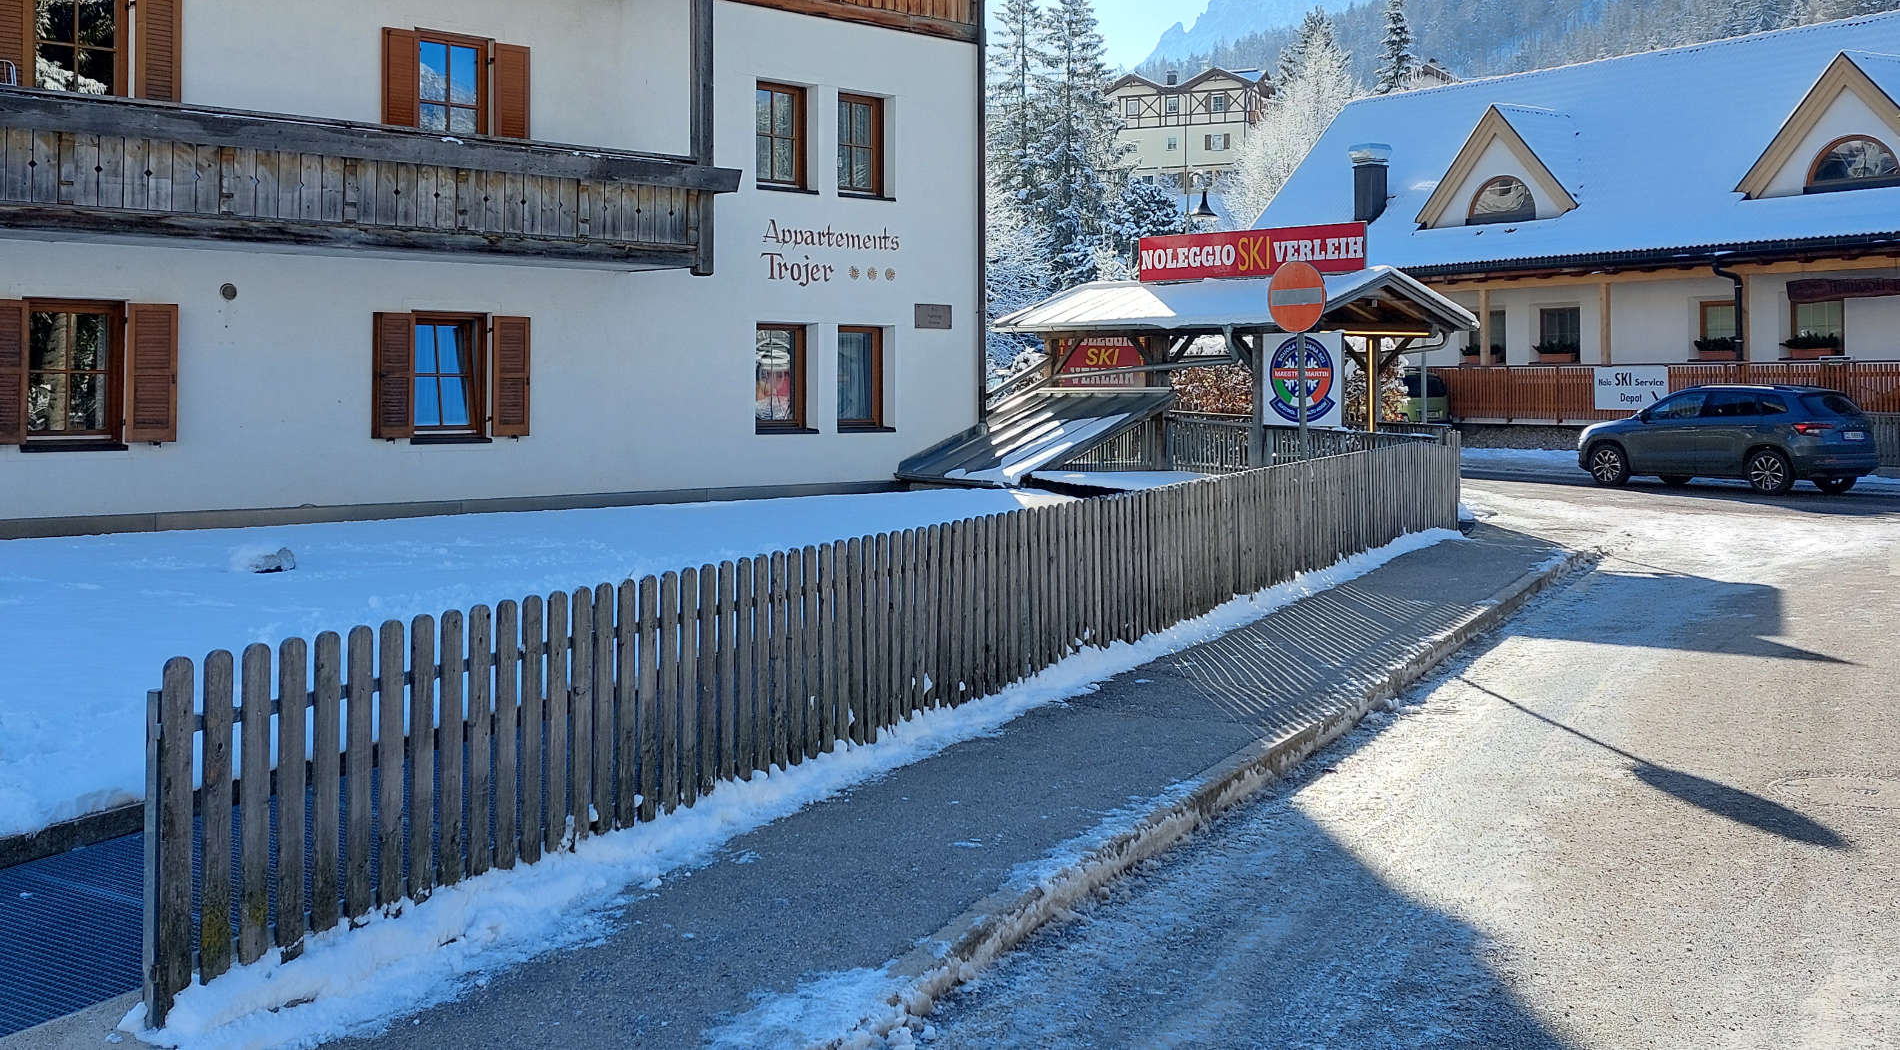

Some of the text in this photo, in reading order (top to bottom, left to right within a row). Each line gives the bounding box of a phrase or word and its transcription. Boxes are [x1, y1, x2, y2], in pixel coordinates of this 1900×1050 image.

[762, 219, 900, 251] Appartements
[1141, 236, 1364, 271] NOLEGGIO SKI VERLEIH
[760, 252, 834, 287] Trojer
[1085, 348, 1119, 365] SKI
[1614, 372, 1632, 386] SKI
[1634, 378, 1664, 386] Service
[1620, 392, 1642, 404] Depot
